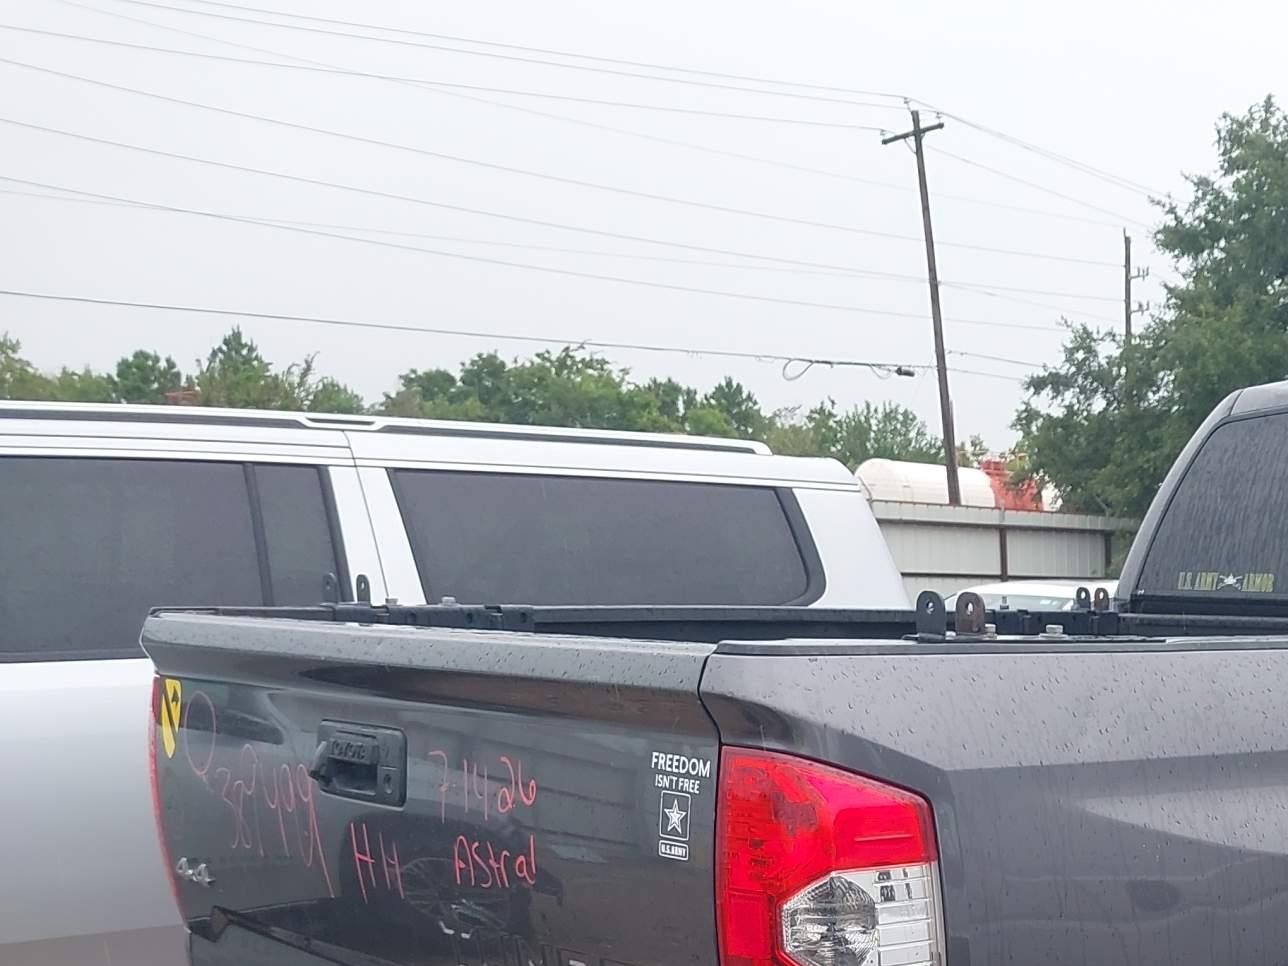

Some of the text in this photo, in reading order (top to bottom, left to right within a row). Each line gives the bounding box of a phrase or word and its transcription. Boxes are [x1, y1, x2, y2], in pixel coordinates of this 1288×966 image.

[651, 751, 711, 778] FREEDOM
[655, 773, 700, 794] ISN'T FREE
